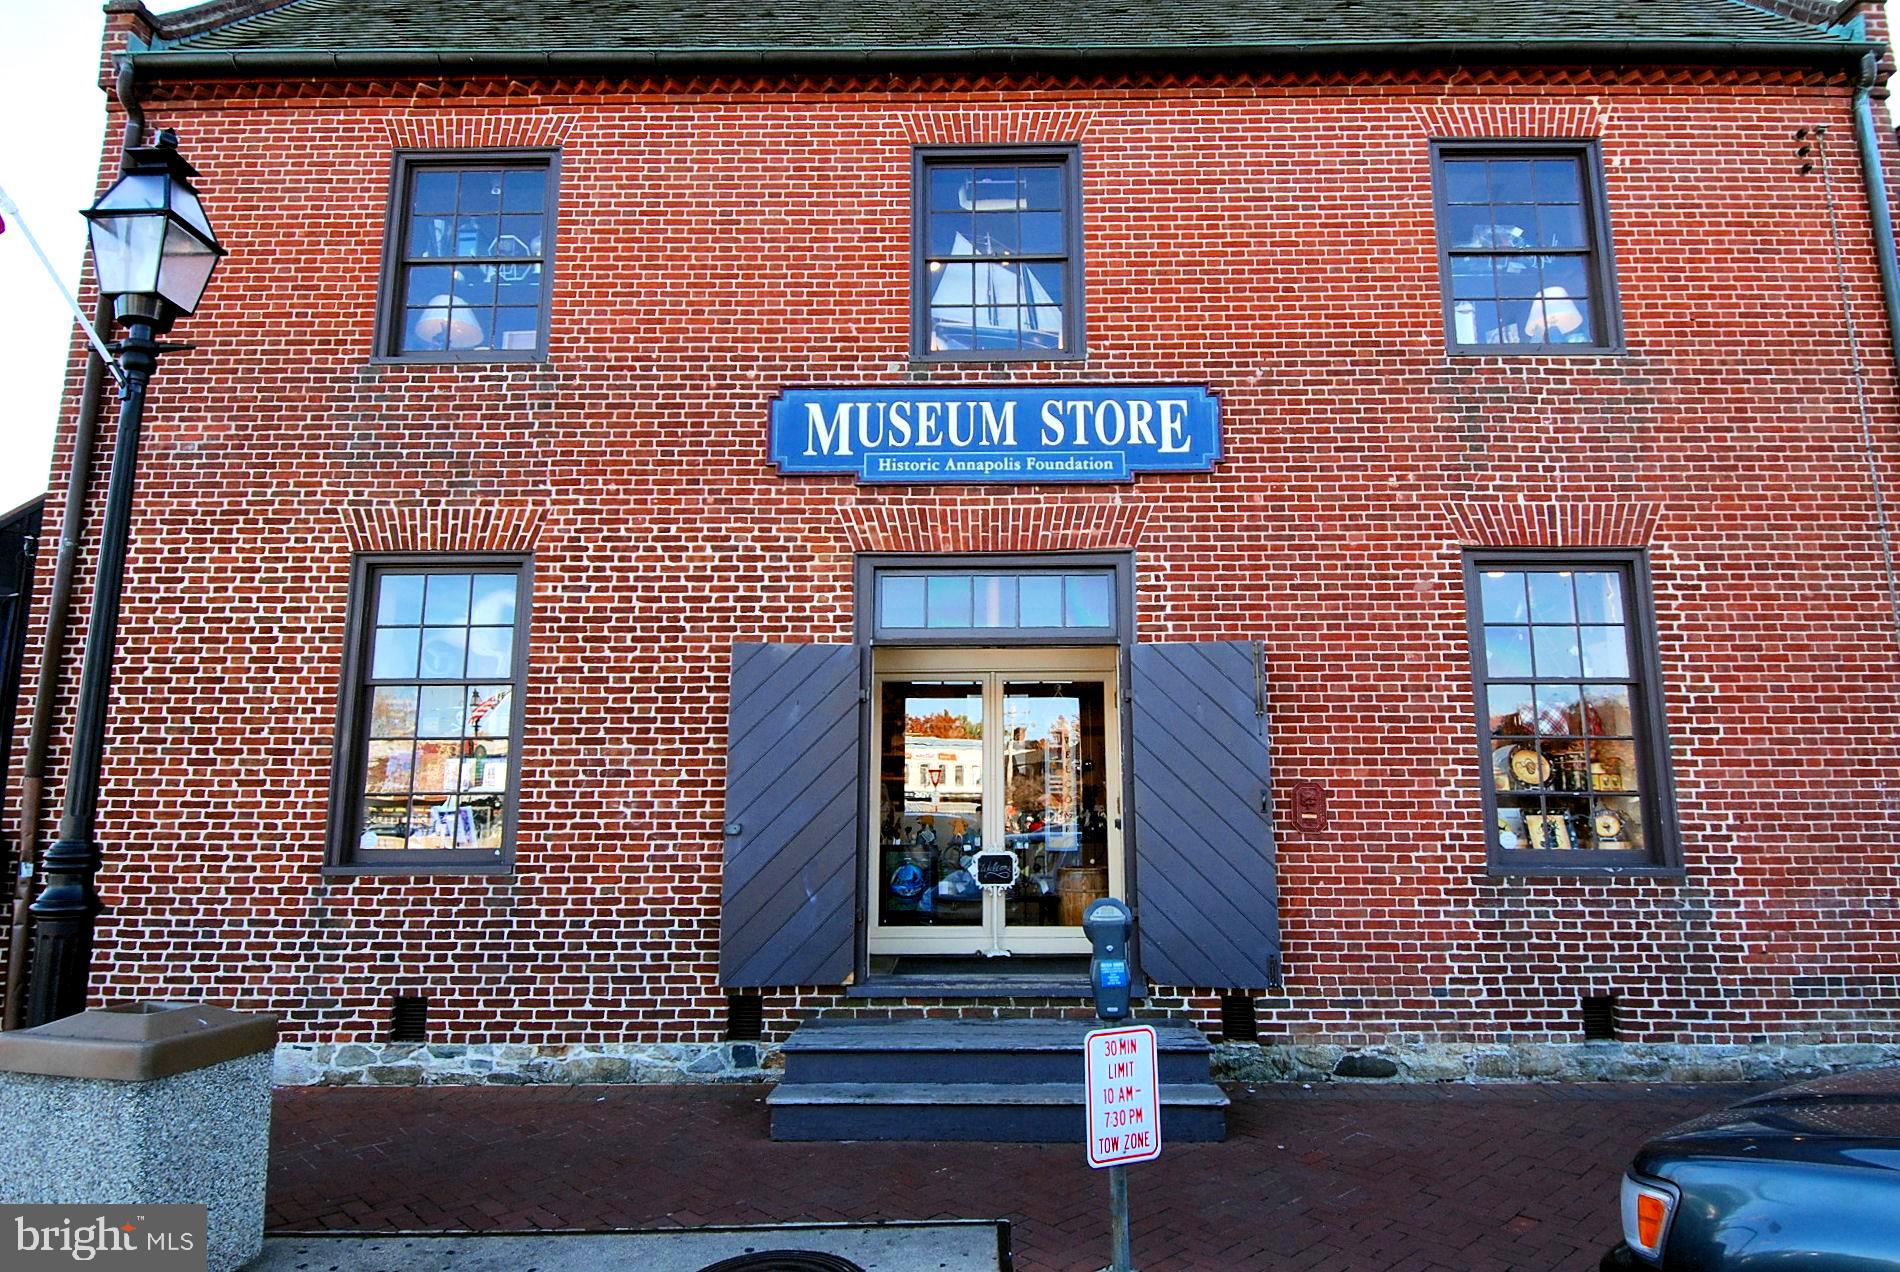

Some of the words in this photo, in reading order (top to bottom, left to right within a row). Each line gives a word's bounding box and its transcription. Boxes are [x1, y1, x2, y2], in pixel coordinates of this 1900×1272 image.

[803, 399, 1018, 457] MUSEUM
[1040, 398, 1192, 454] STORE
[878, 457, 942, 472] Historic
[945, 457, 1021, 475] Annapolis
[1026, 456, 1114, 471] Foundation
[1104, 1040, 1117, 1057] 30
[1119, 1038, 1137, 1055] MIN
[1108, 1061, 1134, 1080] LIMIT
[1103, 1088, 1115, 1105] 10
[1129, 1106, 1143, 1125] PM
[1098, 1136, 1120, 1155] TOW
[1124, 1131, 1150, 1150] ZONE
